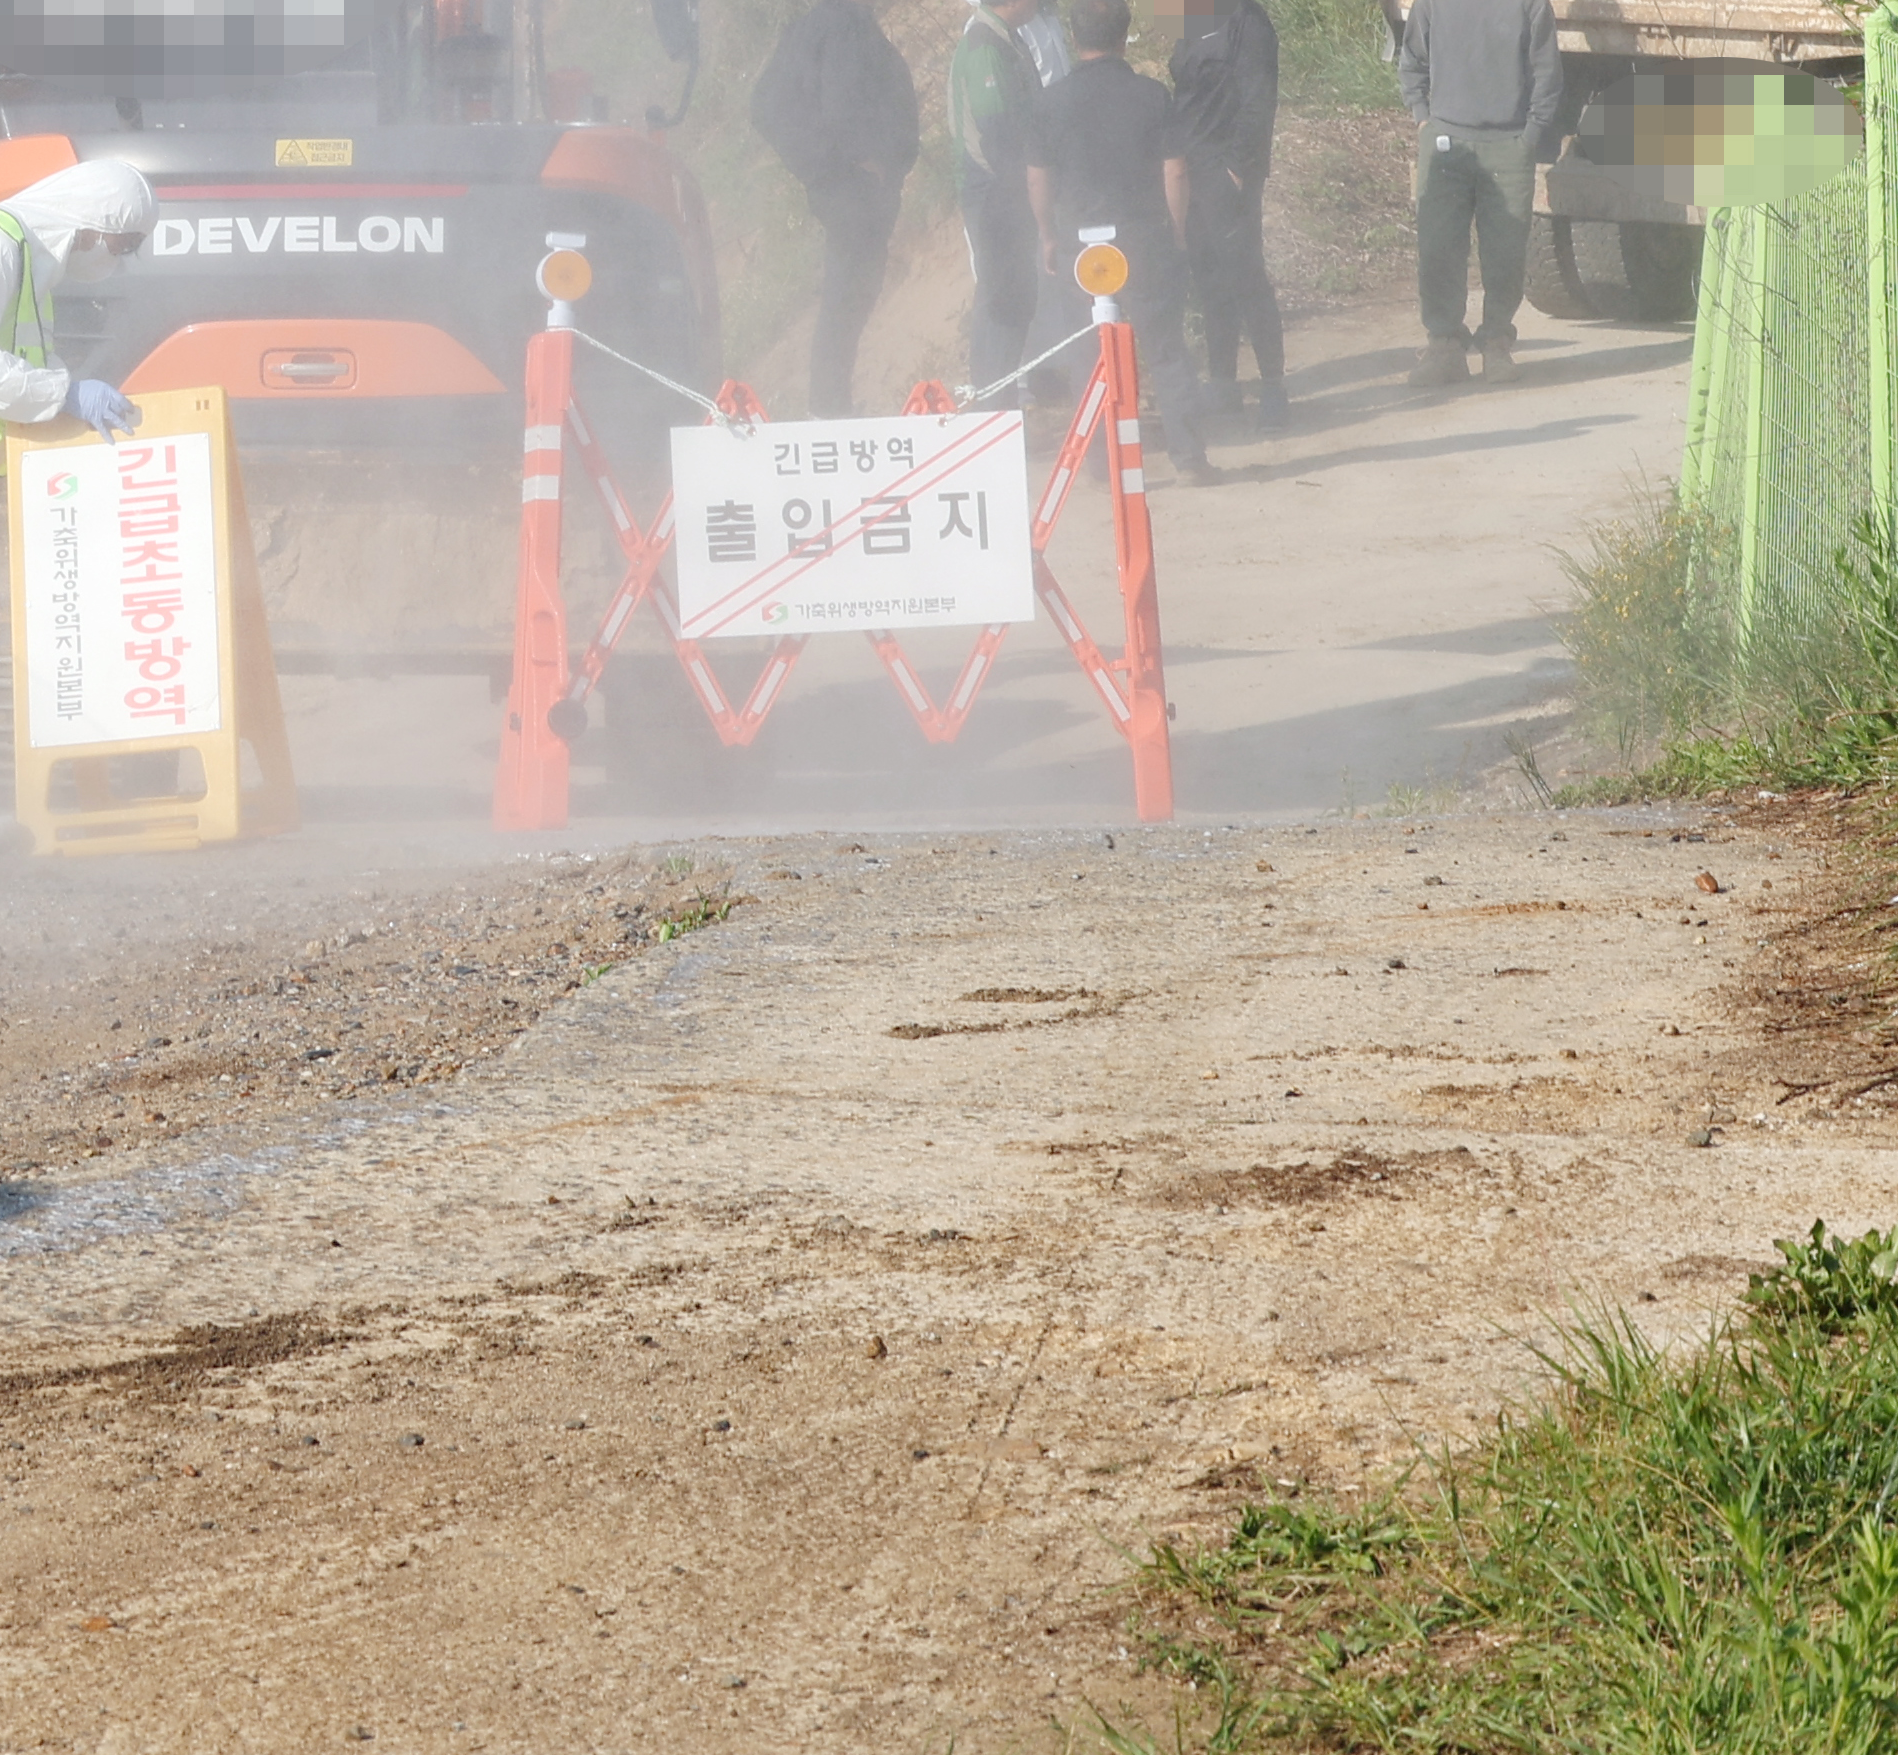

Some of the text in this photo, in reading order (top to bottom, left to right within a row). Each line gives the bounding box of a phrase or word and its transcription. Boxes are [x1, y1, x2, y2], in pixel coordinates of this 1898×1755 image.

[153, 216, 444, 256] DEVELON
[774, 437, 914, 476] 긴급방역
[705, 491, 989, 563] 출입금지
[117, 445, 192, 725] 긴급초동방역
[794, 597, 956, 619] 가축위생방역지원본부
[50, 506, 83, 721] 가축위생방역지원본부
